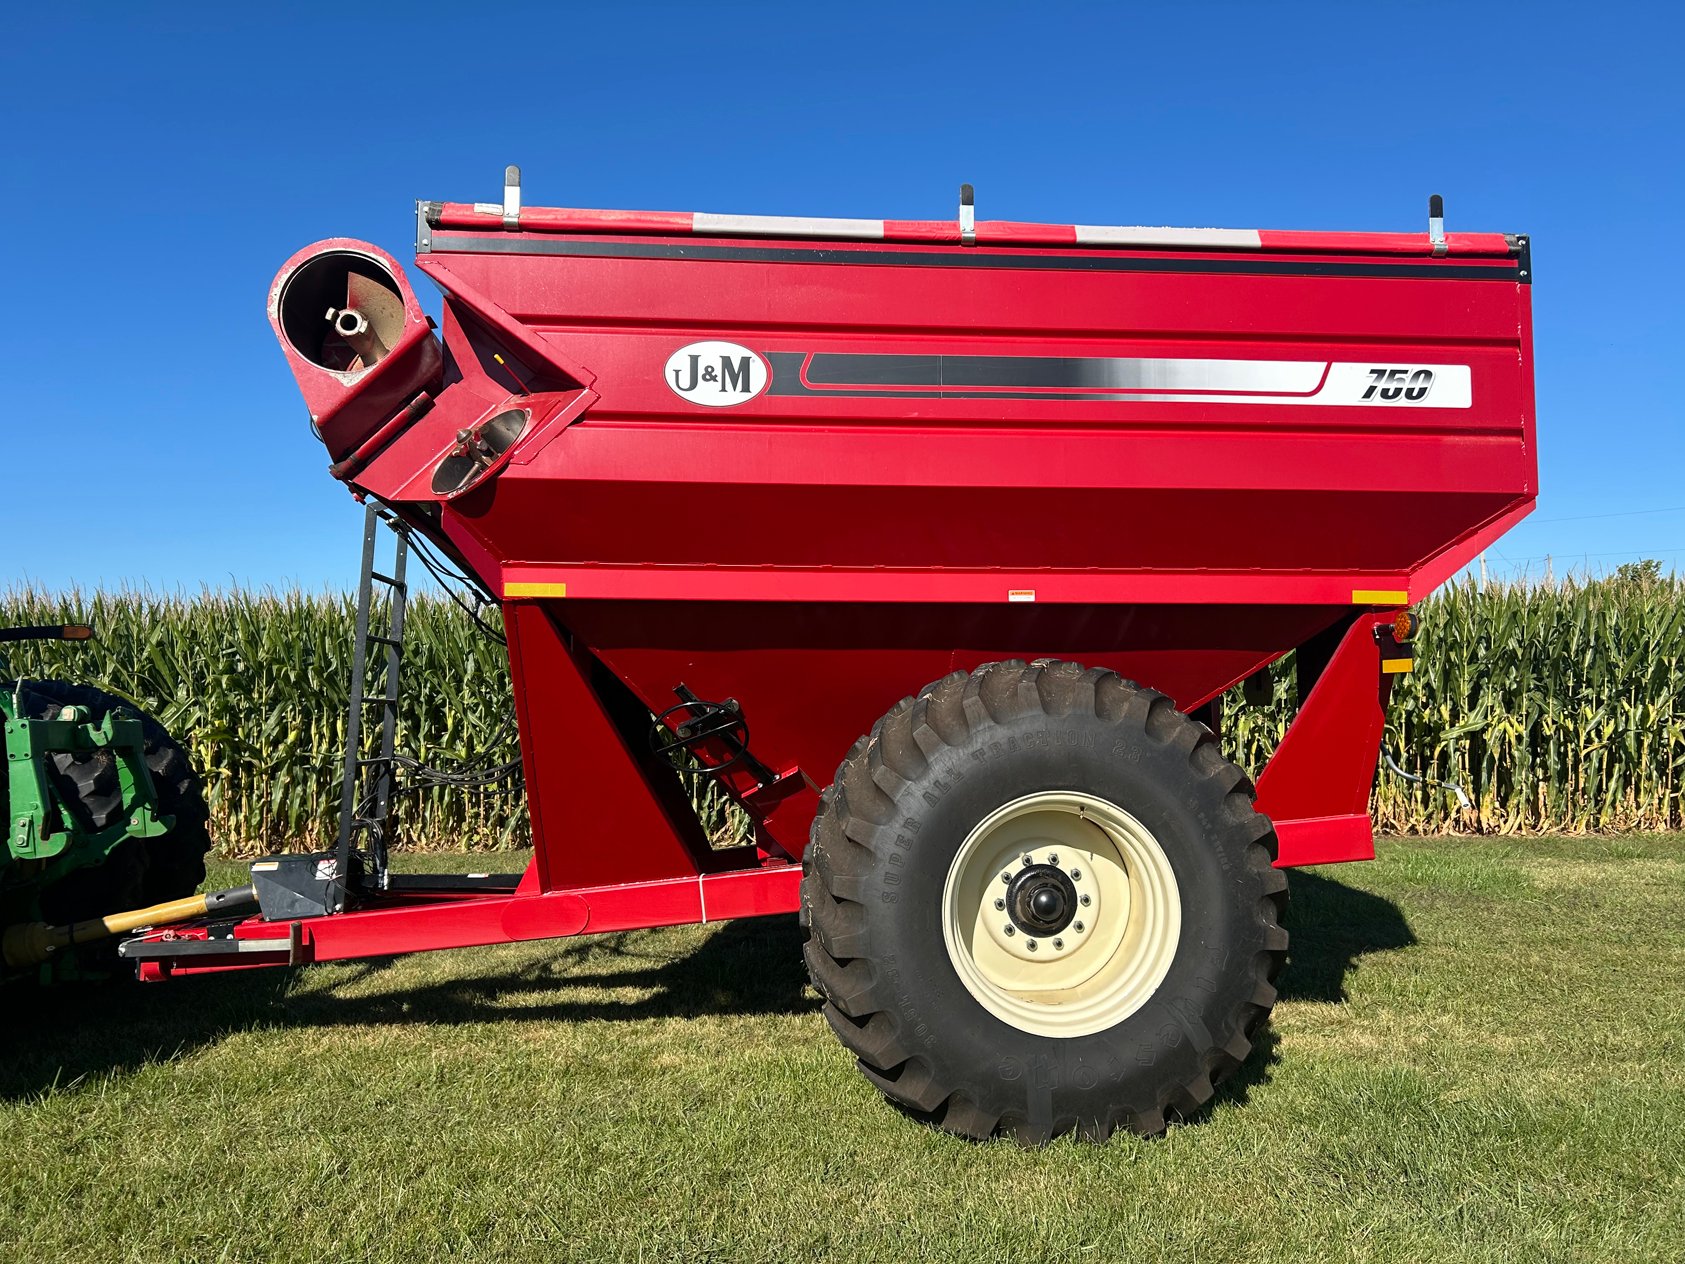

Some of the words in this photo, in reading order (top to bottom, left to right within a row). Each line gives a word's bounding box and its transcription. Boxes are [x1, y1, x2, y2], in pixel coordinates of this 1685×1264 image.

[672, 354, 752, 393] J&M
[1360, 368, 1434, 402] 750
[881, 816, 922, 905] SUPER
[922, 768, 965, 808] ALL
[970, 728, 1097, 766] TRACTION
